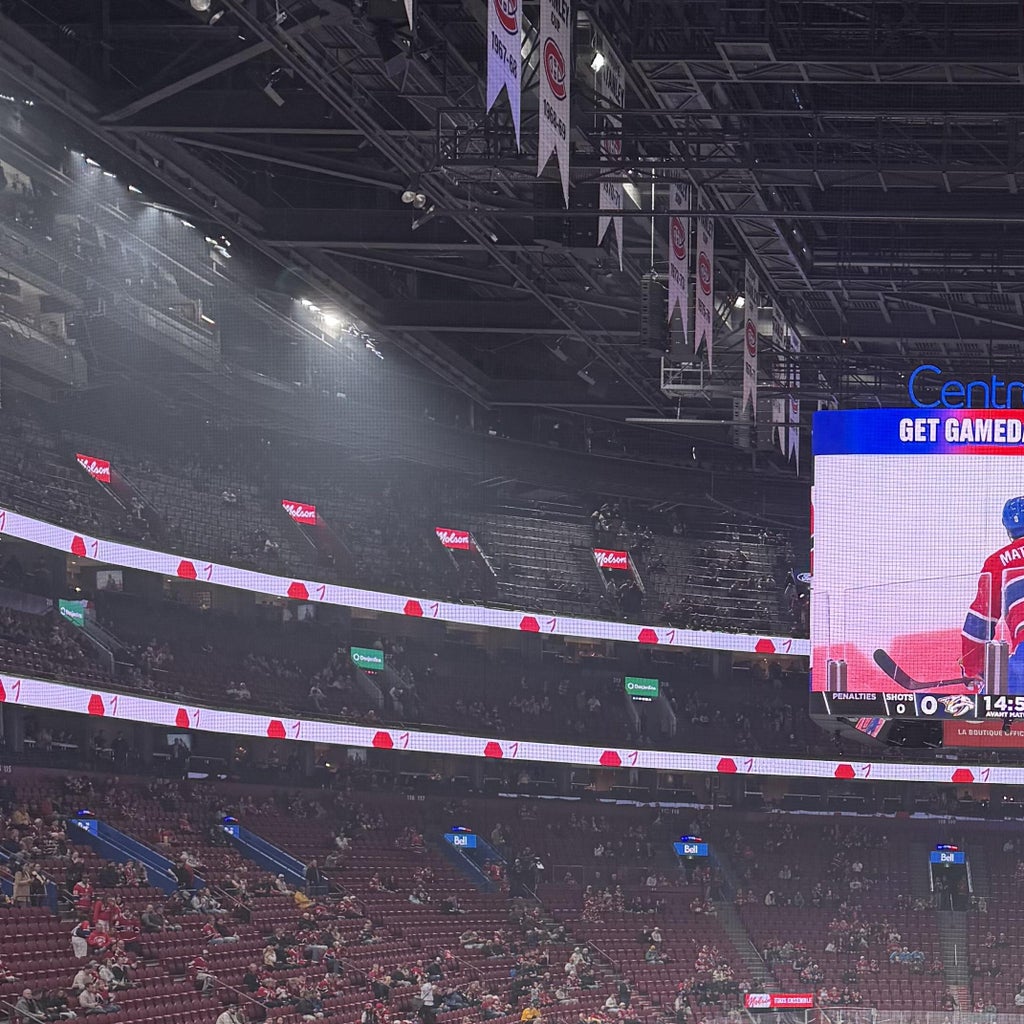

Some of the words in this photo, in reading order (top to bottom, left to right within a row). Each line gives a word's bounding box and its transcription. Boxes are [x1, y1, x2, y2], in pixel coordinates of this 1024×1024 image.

[899, 418, 941, 443] GET
[832, 692, 877, 702] PENALTIES
[886, 694, 914, 702] SHOTS
[896, 703, 905, 714] 0
[921, 696, 938, 714] 0
[958, 729, 967, 737] LA
[968, 729, 1003, 738] BOUTIQUE
[453, 836, 468, 846] Bell
[684, 845, 698, 854] Bell
[940, 853, 954, 862] Bell
